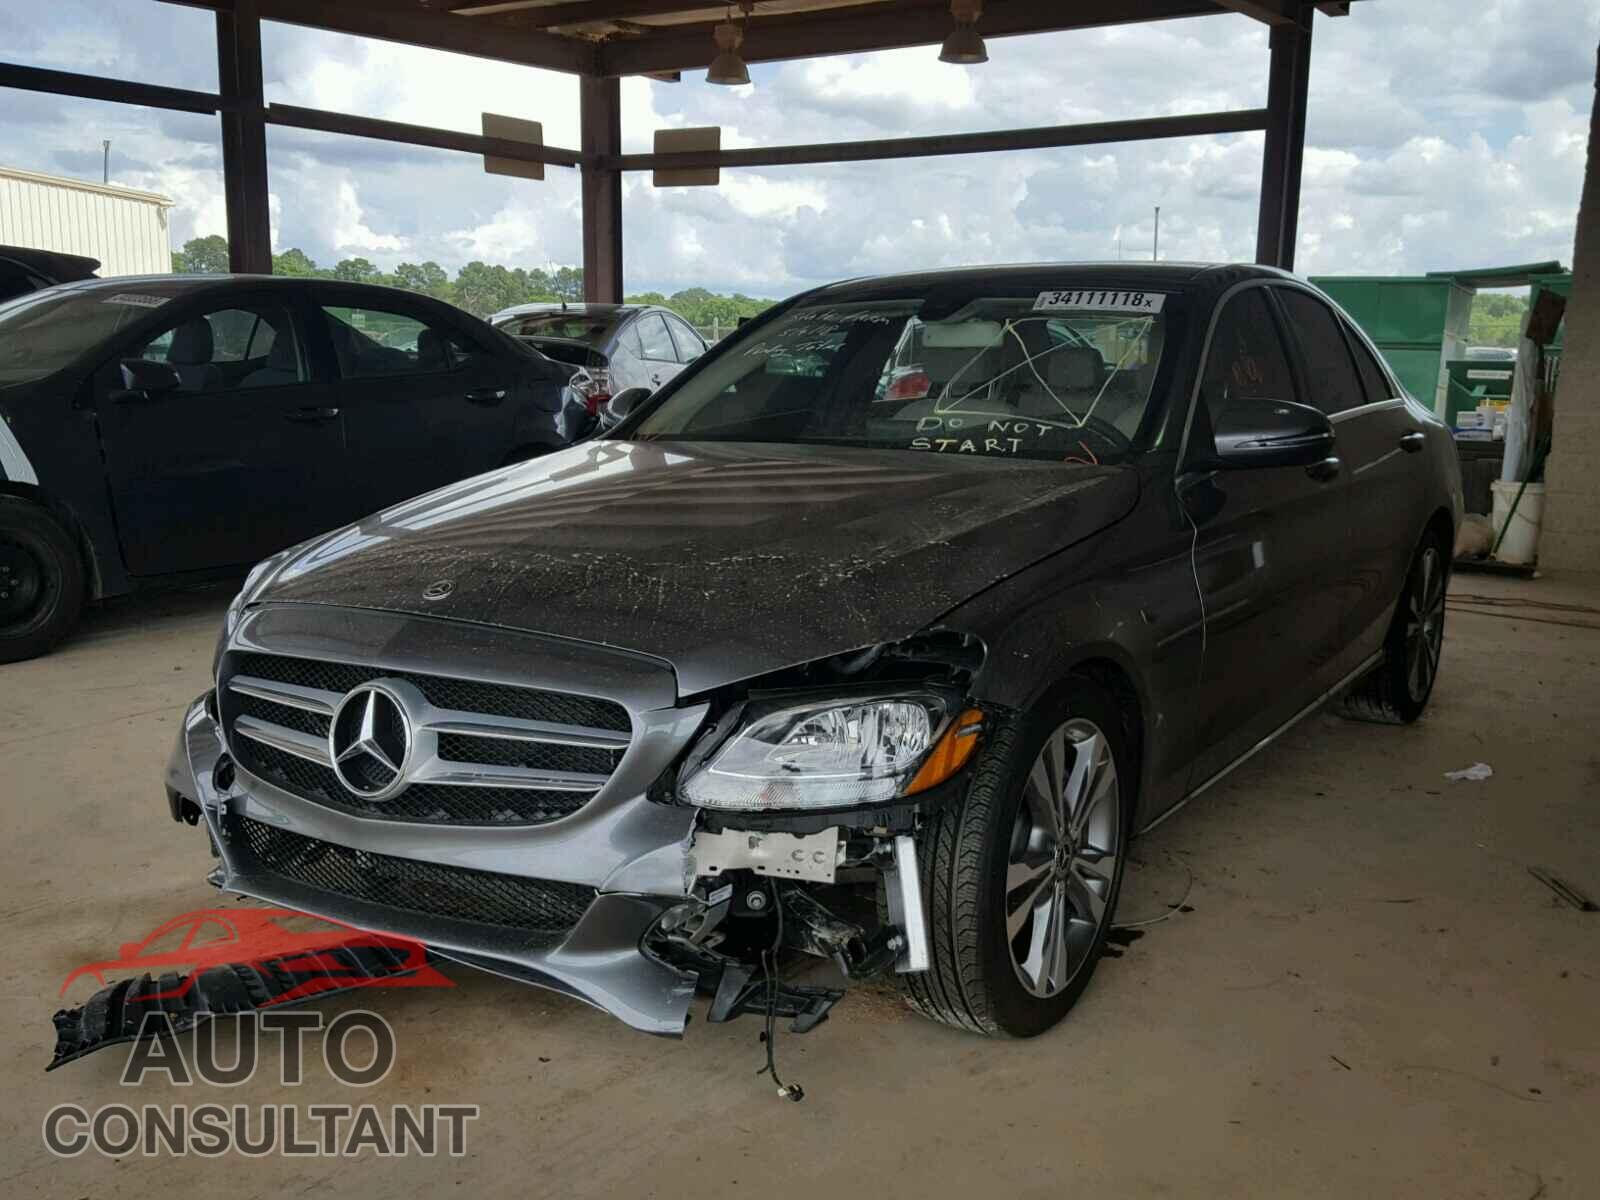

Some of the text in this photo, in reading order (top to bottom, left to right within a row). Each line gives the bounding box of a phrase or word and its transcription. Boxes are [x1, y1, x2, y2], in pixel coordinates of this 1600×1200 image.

[916, 416, 1053, 436] DO NOT
[909, 437, 1023, 453] START
